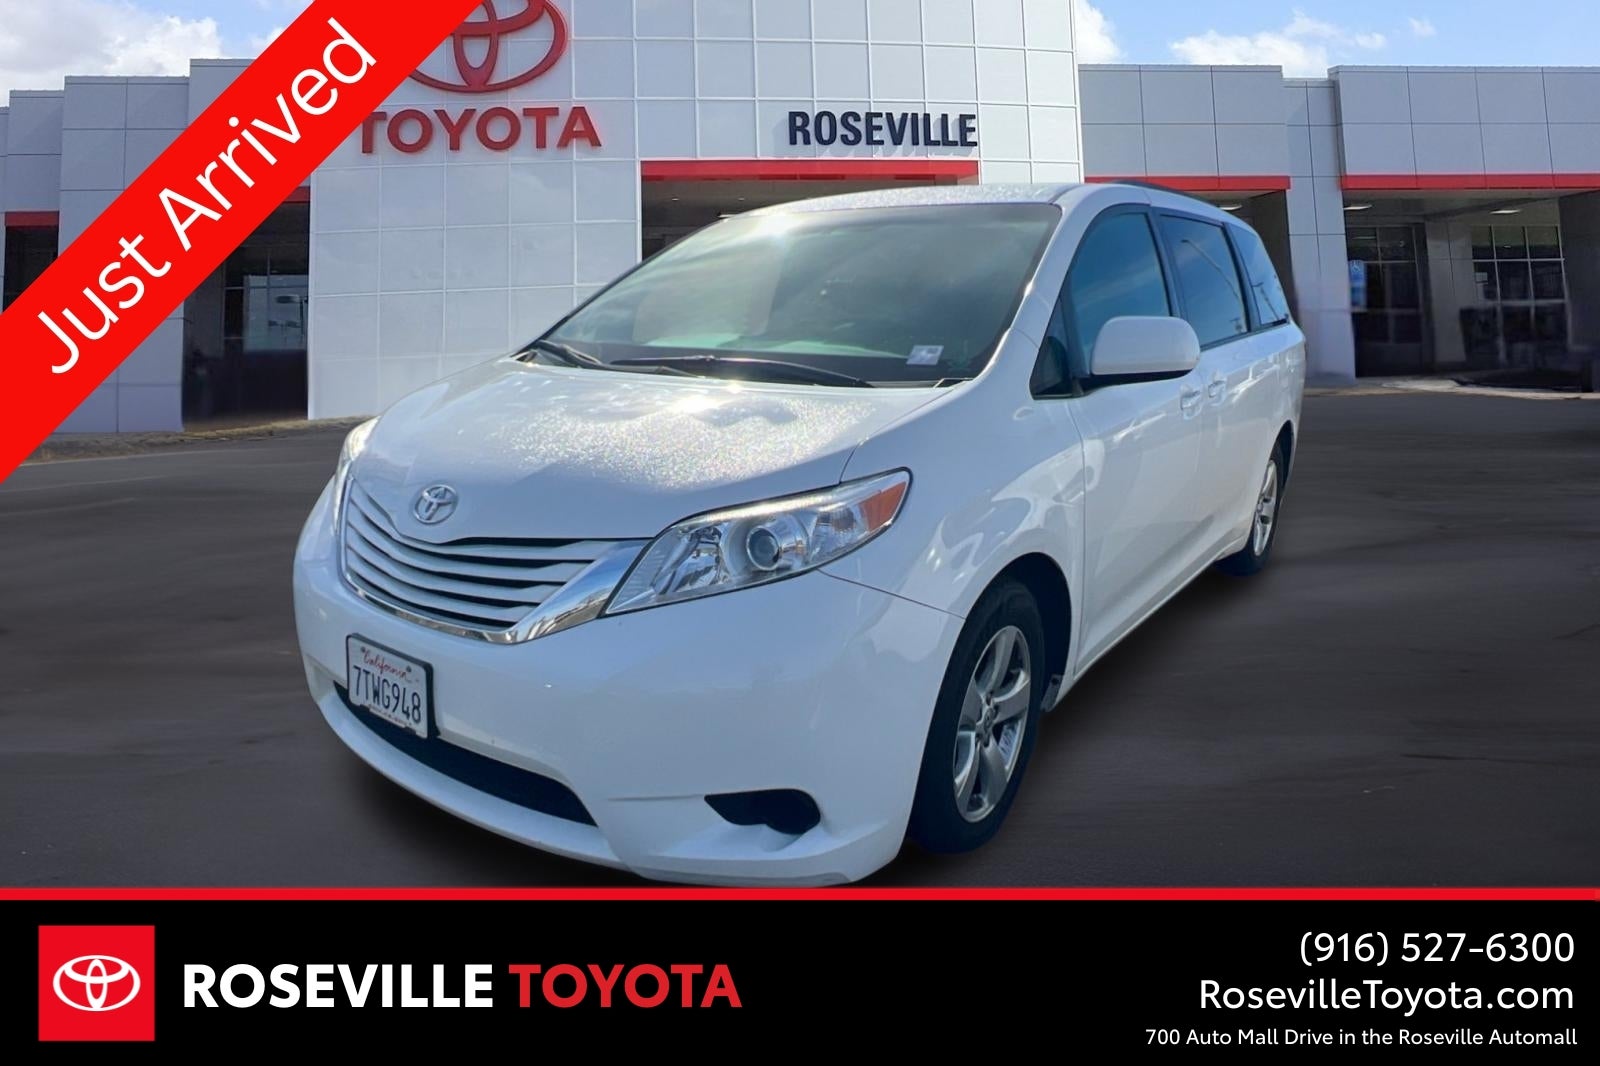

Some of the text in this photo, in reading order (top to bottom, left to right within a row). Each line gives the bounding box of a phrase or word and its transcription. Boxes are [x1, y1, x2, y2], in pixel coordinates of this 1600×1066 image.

[360, 105, 602, 154] TOYOTA
[788, 110, 978, 147] ROSEVILLE
[363, 650, 411, 683] California
[353, 664, 421, 724] 7TWG948
